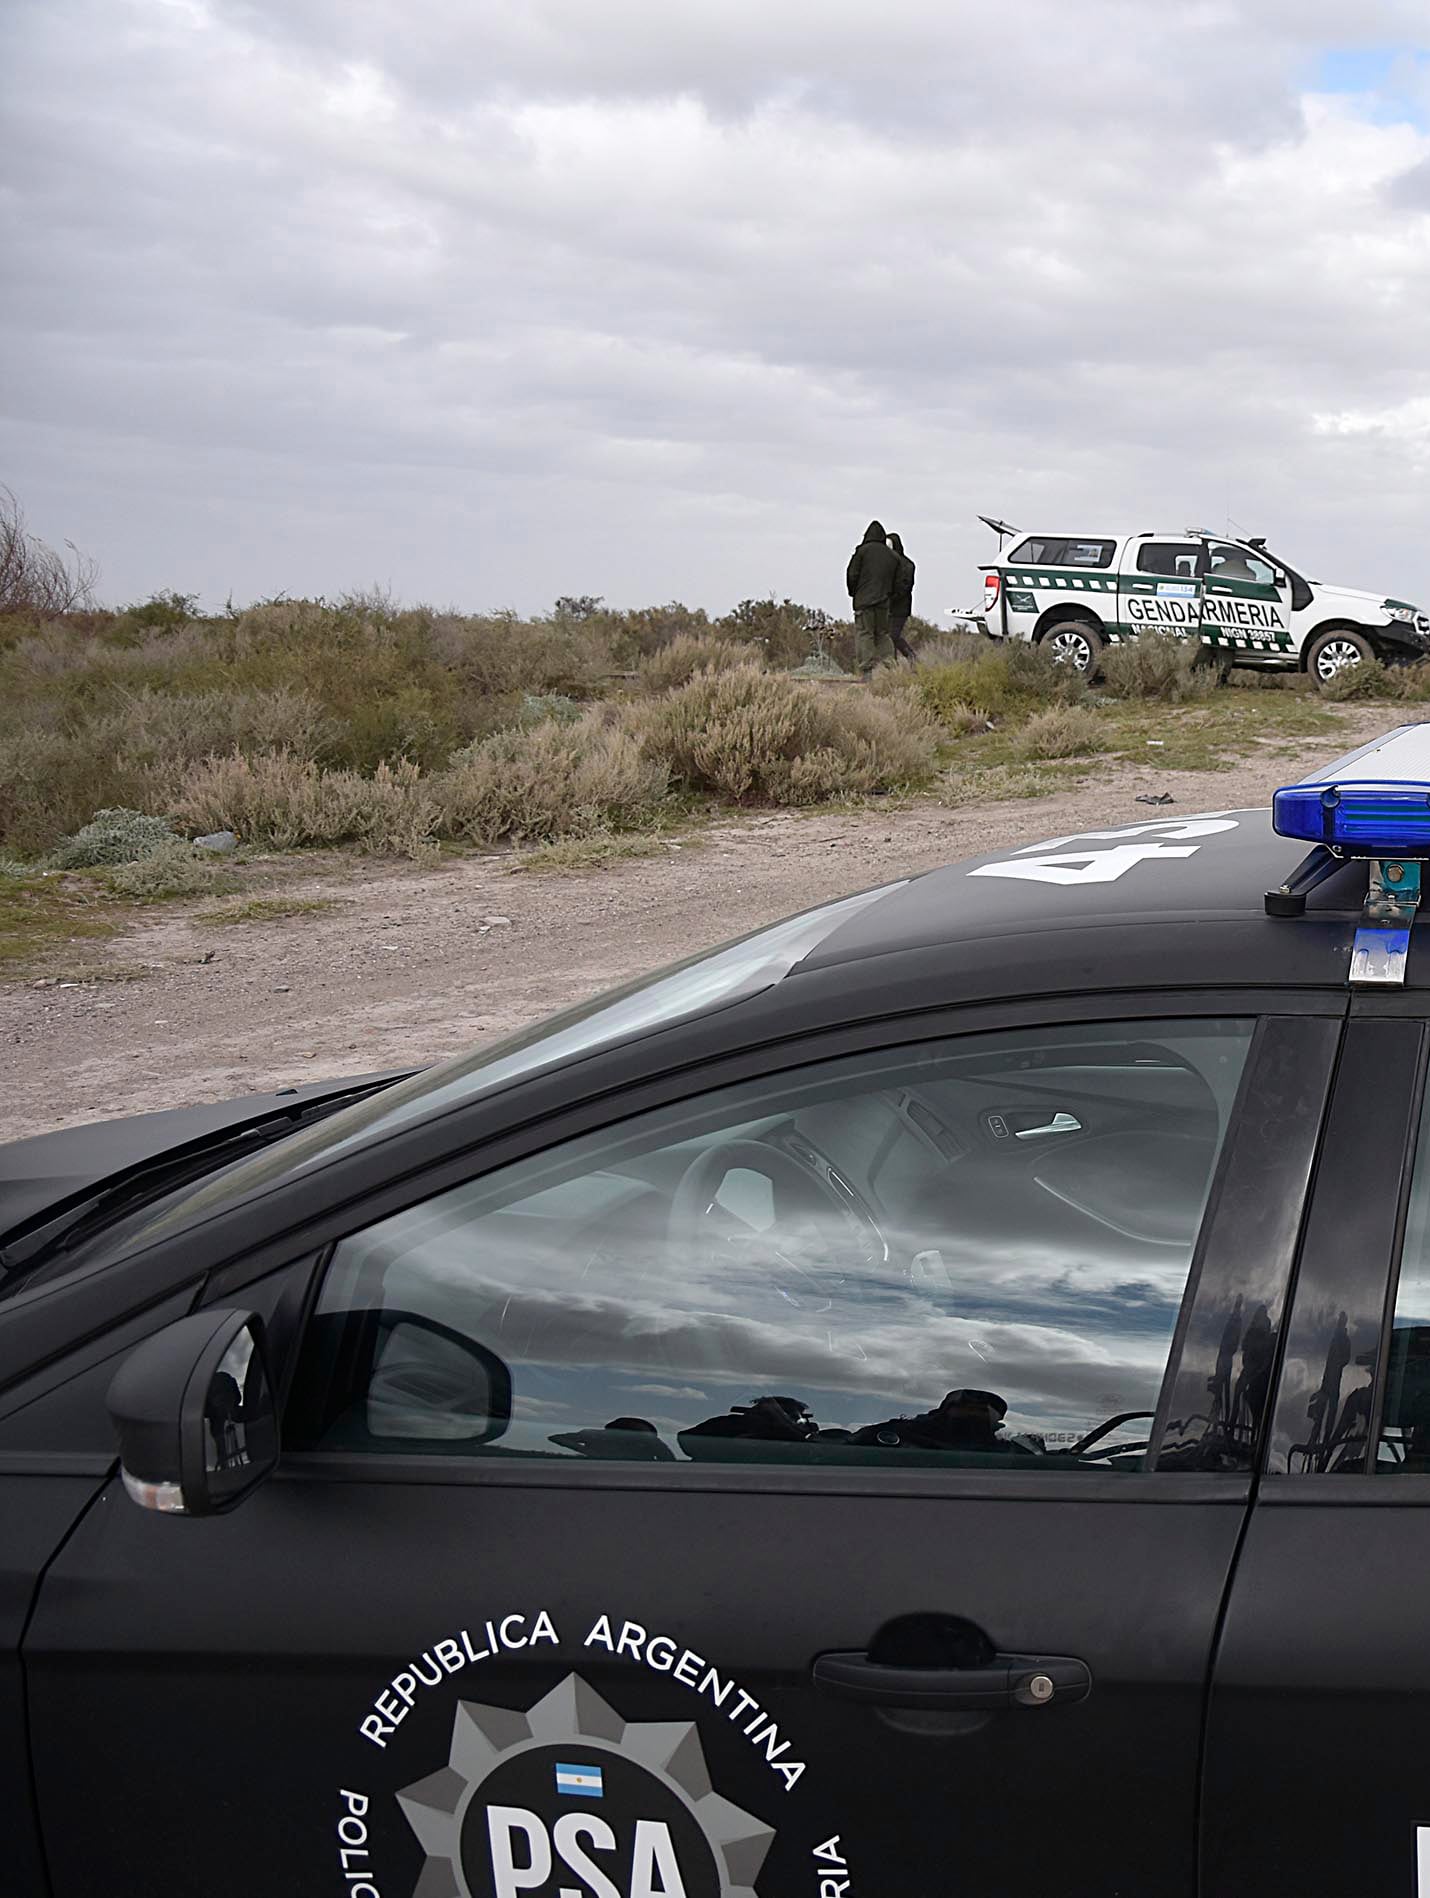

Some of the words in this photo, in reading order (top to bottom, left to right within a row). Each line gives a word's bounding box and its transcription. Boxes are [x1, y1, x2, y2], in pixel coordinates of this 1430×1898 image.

[1128, 599, 1285, 628] GENDARMERIA
[359, 1611, 560, 1748] REPUBLICA
[583, 1614, 807, 1792] ARGENTINA
[486, 1804, 688, 1898] PSA
